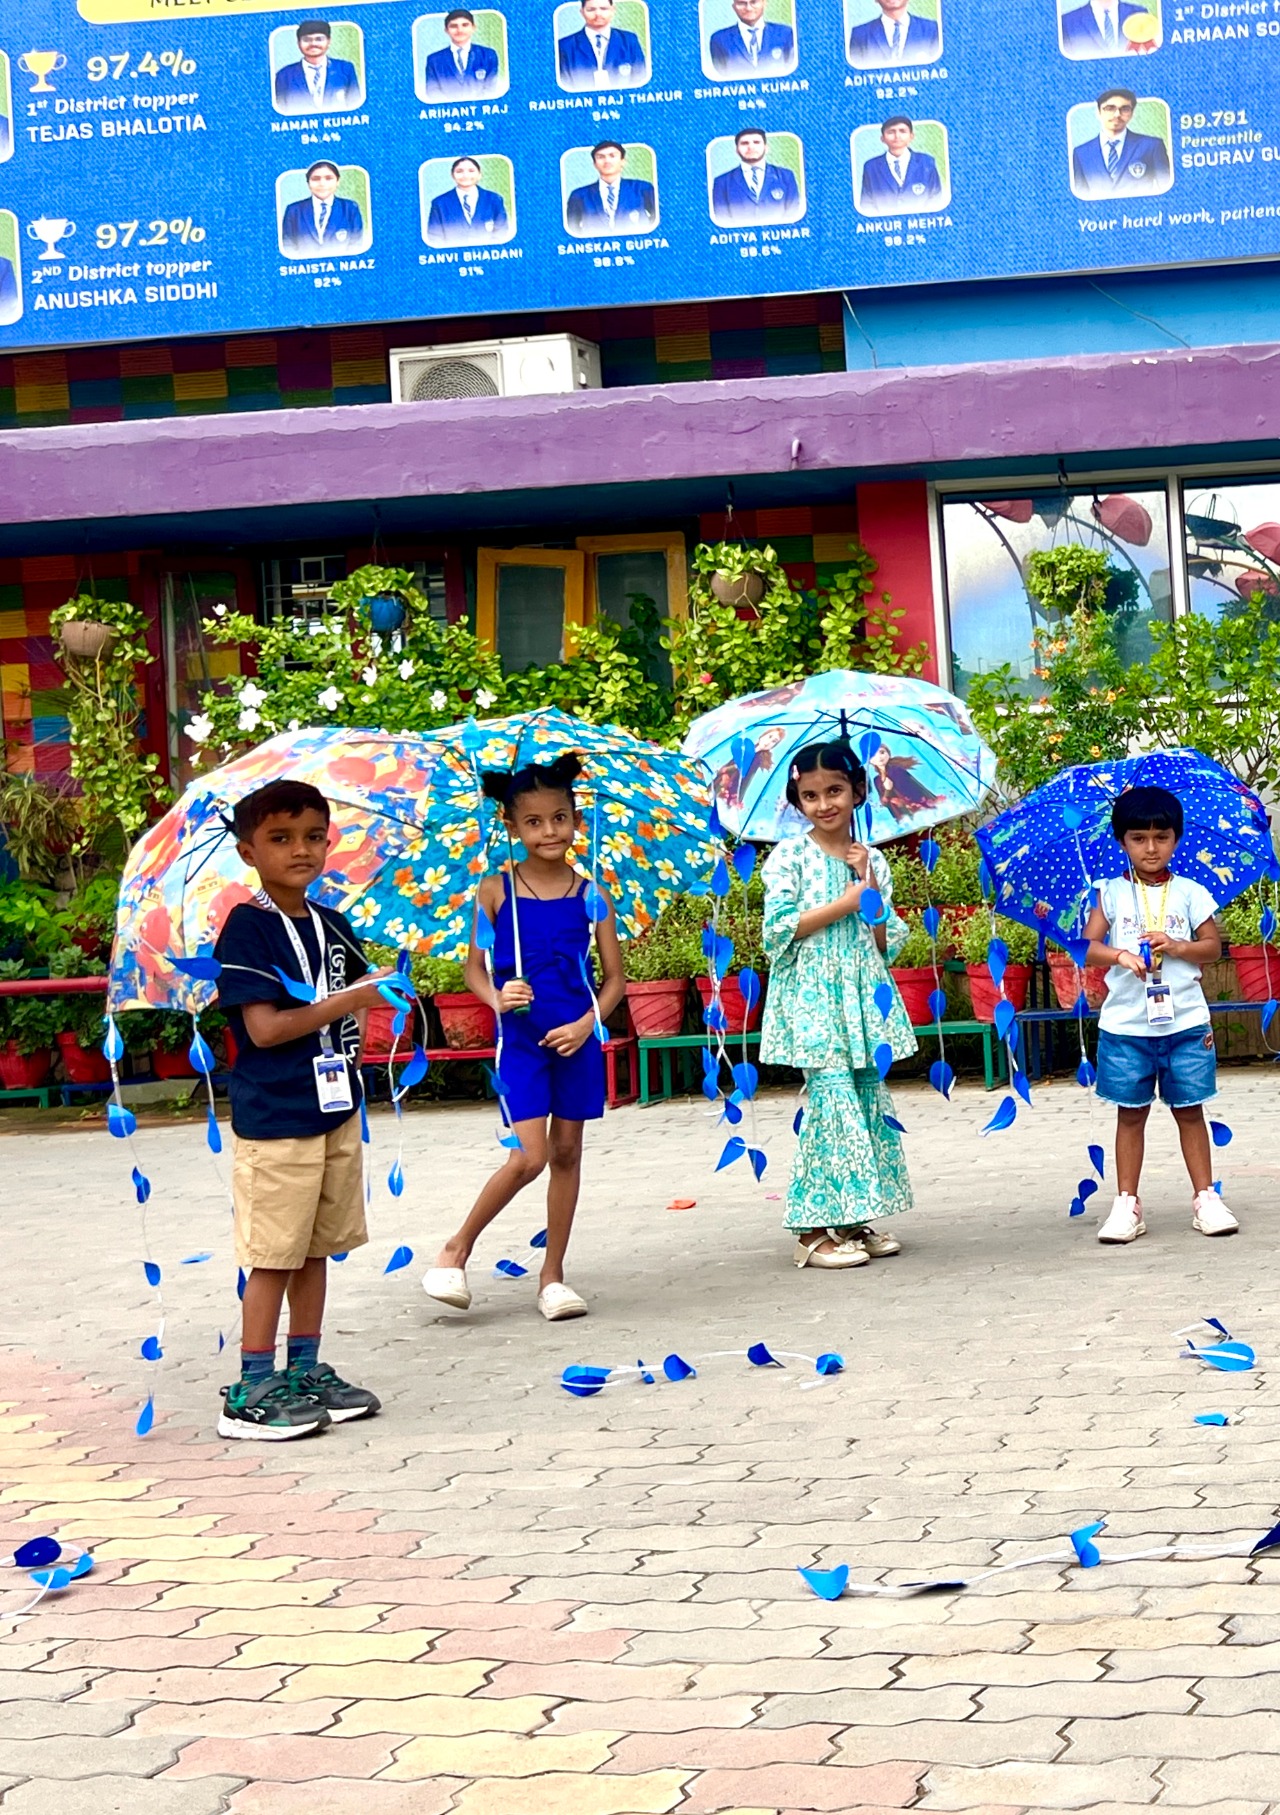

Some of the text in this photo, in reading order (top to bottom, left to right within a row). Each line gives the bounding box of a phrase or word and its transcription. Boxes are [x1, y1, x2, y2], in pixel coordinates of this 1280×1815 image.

[1174, 5, 1194, 22] 1st
[1201, 1, 1268, 19] District
[1170, 24, 1249, 44] ARMAAN
[86, 48, 197, 82] 97.4%
[844, 67, 949, 87] ADITYAANURAG
[694, 79, 810, 100] SHRAVAN KUMAR
[26, 92, 200, 117] 1st District topper
[529, 90, 683, 112] RAUSHAN RAJ THAKUR
[738, 99, 767, 111] 94%
[419, 104, 509, 120] ARIHANT RAJ
[591, 110, 621, 122] 94%
[1180, 109, 1248, 130] 99.791
[26, 114, 207, 143] TEJAS BHALOTIA
[270, 114, 370, 133] NAMAN KUMAR
[443, 120, 486, 133] 94.2%
[300, 132, 342, 145] 94.4%
[1181, 129, 1263, 149] Percentile
[1181, 148, 1255, 169] SOURAV
[855, 215, 954, 235] ANKUR MEHTA
[1078, 217, 1117, 233] Your
[1122, 210, 1163, 230] hard
[1168, 208, 1215, 226] work,
[95, 216, 207, 250] 97.2%
[709, 226, 811, 246] ADITYA KUMAR
[418, 247, 523, 266] SANVI BHADANI
[556, 236, 670, 257] SANSKAR GUPTA
[31, 259, 213, 285] 2ND District topper
[279, 258, 376, 277] SHAISTA NAAZ
[458, 265, 485, 277] 91%
[313, 276, 343, 289] 92%
[33, 281, 219, 311] ANUSHKA SIDDHI
